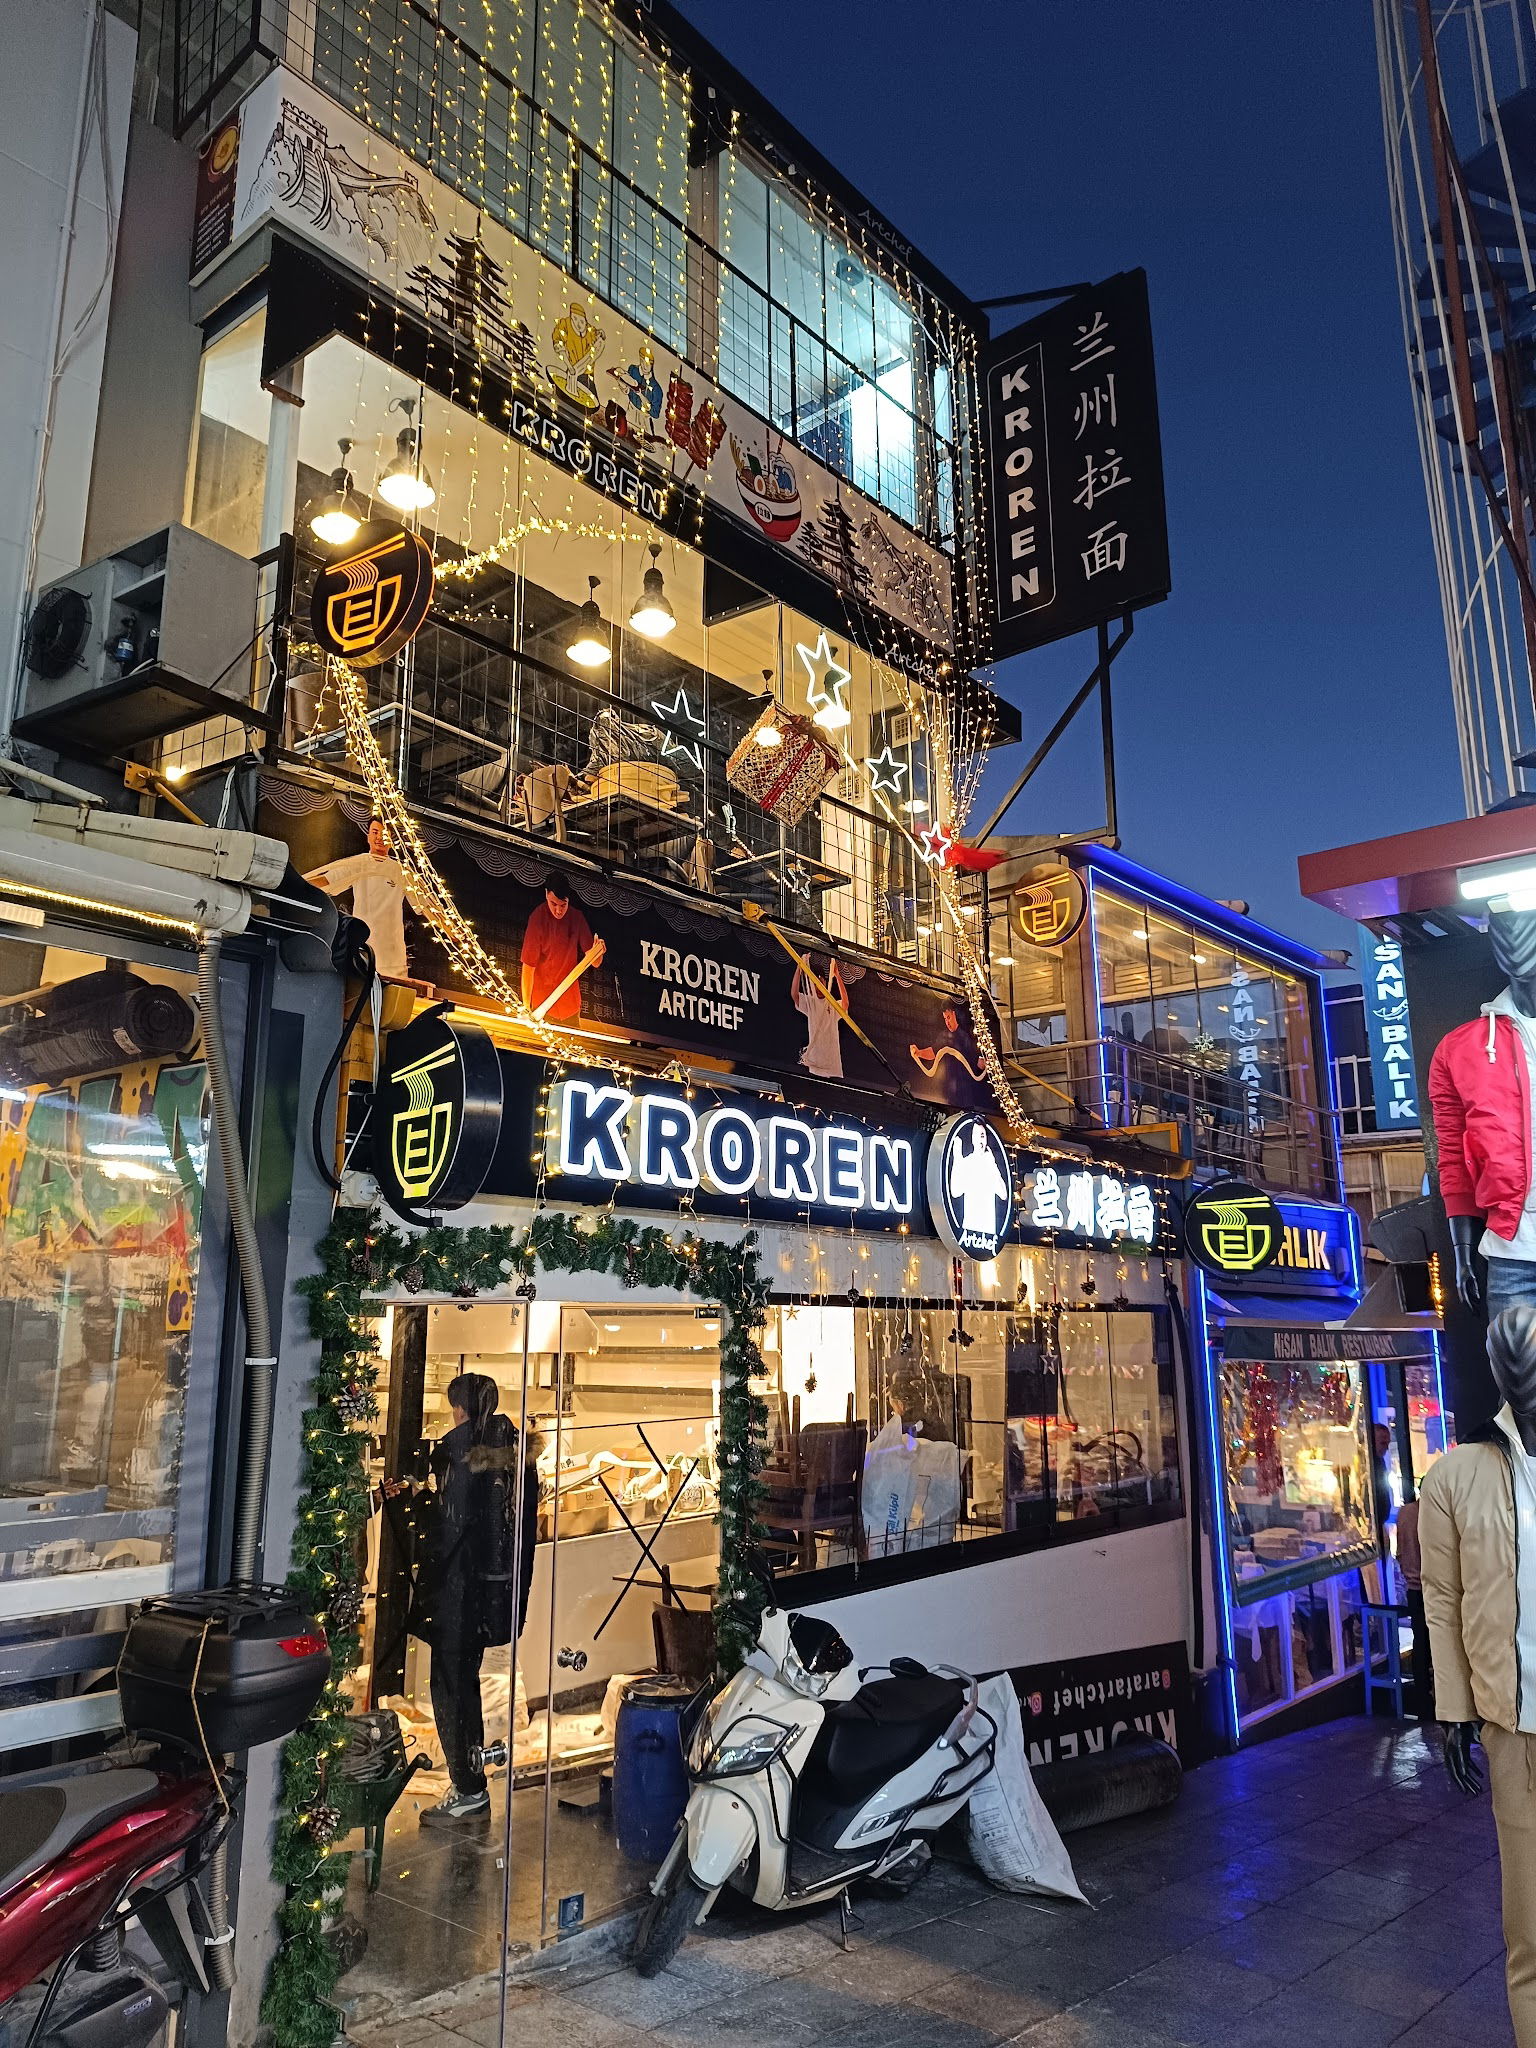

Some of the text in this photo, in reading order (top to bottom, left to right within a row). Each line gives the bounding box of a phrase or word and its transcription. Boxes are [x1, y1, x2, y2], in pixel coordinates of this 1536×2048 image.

[857, 209, 913, 264] Artchef
[512, 400, 664, 521] KROREN
[1070, 311, 1132, 581] 兰州拉面
[1001, 364, 1040, 602] KROREN
[640, 940, 760, 1005] KROREN
[658, 988, 744, 1030] ARTCHEF
[1373, 934, 1418, 1119] SAN BALIK
[558, 1079, 913, 1214] KROREN
[958, 1229, 998, 1256] Artchef
[1271, 1226, 1331, 1270] ALIK
[1309, 1333, 1339, 1358] BALIK
[1341, 1334, 1398, 1358] RESTAURANT
[1053, 1670, 1160, 1716] arafartchef
